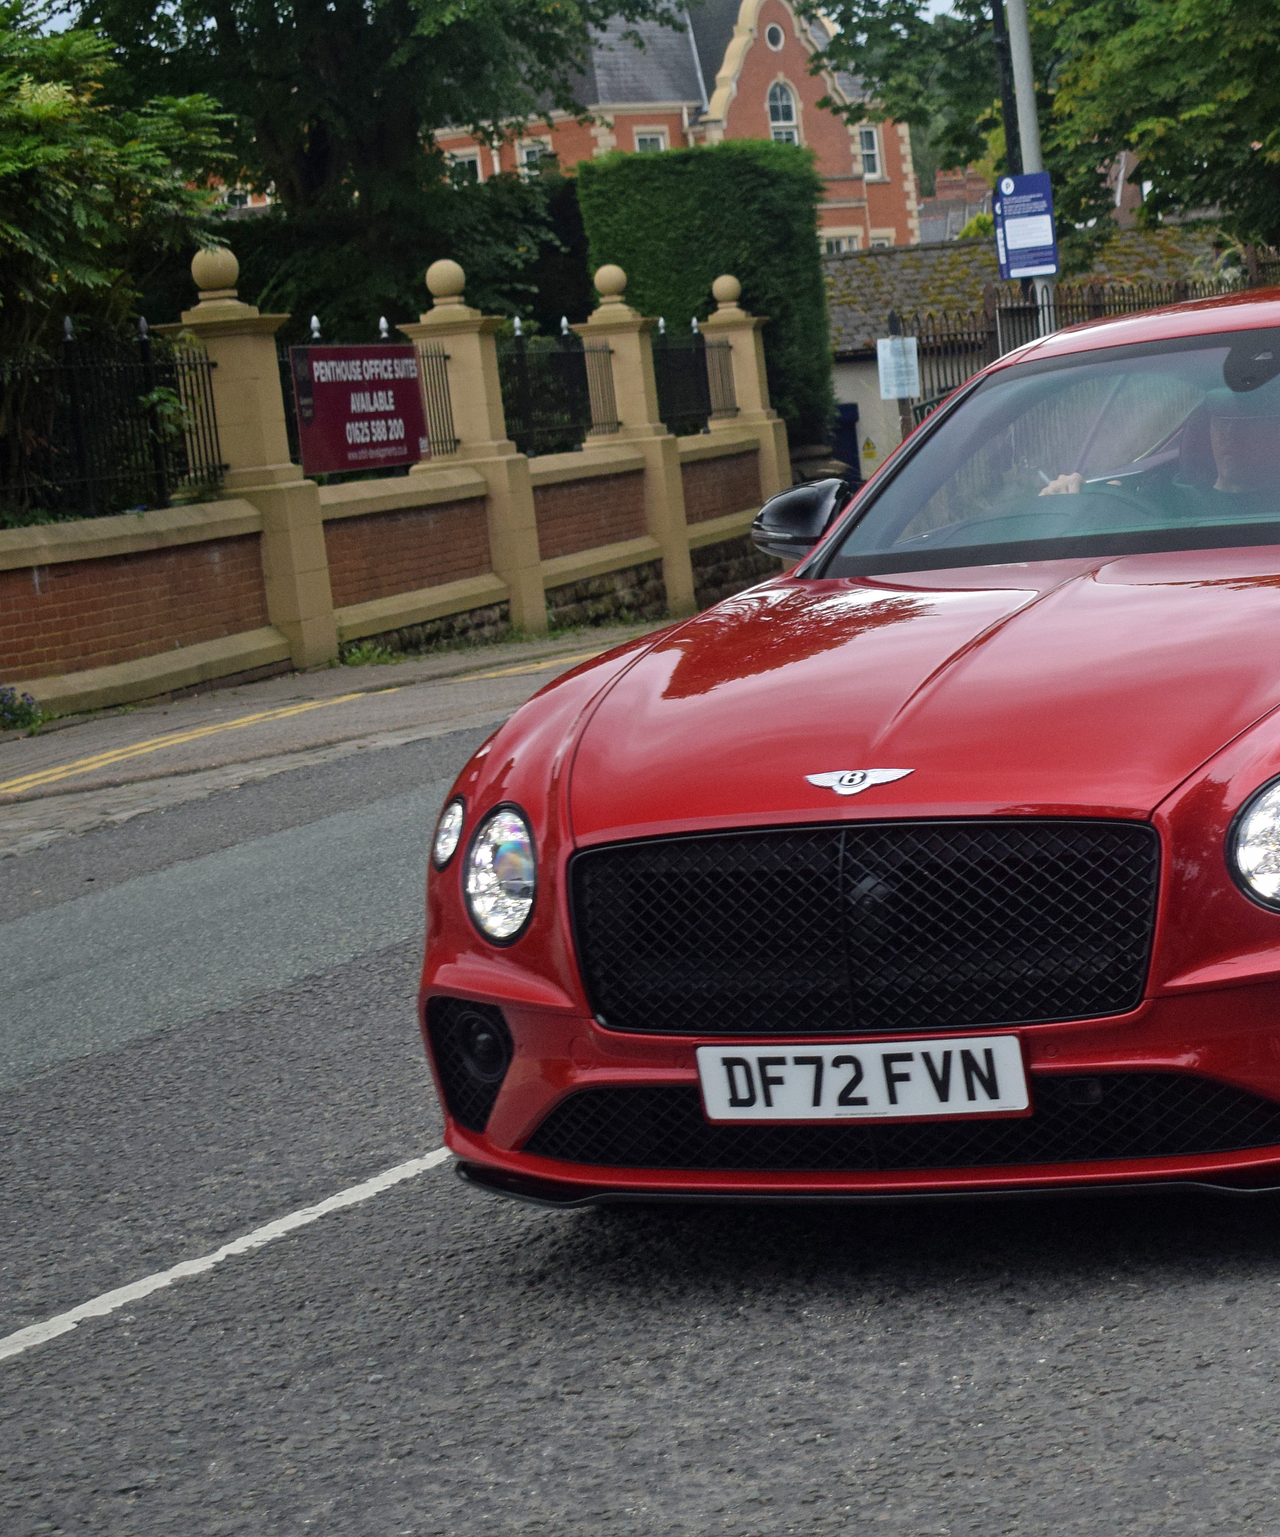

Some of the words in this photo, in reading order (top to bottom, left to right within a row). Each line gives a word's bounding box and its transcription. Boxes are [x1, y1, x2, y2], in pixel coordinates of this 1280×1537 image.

[313, 359, 363, 382] PENTHOUSE
[363, 358, 394, 380] OFFICE
[394, 358, 418, 379] SUITES
[350, 389, 395, 414] AVAILABLE
[345, 421, 370, 445] 01625
[388, 418, 405, 440] 200
[720, 1054, 868, 1108] DF72
[881, 1047, 1000, 1105] FVN
